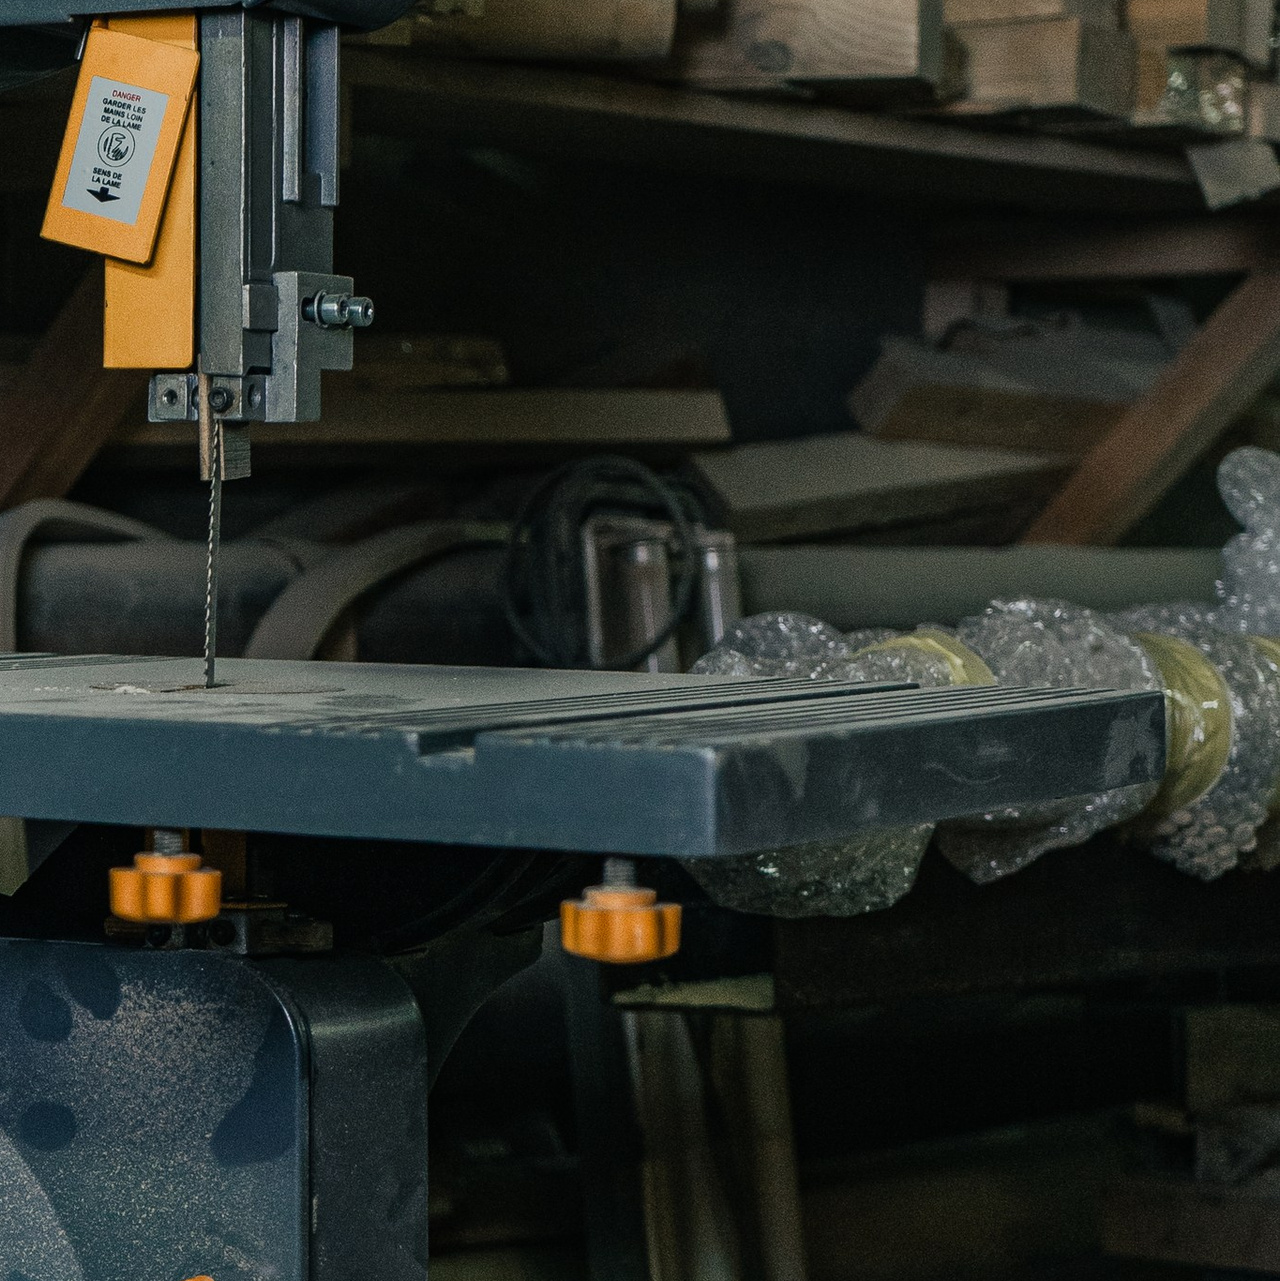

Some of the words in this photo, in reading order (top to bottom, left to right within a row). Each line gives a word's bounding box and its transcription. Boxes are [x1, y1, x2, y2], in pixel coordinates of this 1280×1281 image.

[112, 89, 141, 102] DANGER
[102, 97, 132, 111] GARDER
[133, 105, 147, 115] LES
[101, 114, 111, 123] DE
[112, 118, 121, 127] LA
[122, 120, 142, 131] LAME
[103, 106, 125, 118] MAINS
[127, 112, 144, 123] LOIN
[93, 166, 111, 178] SENS
[112, 172, 122, 181] DE
[91, 175, 101, 184] LA
[102, 178, 122, 189] LAME
